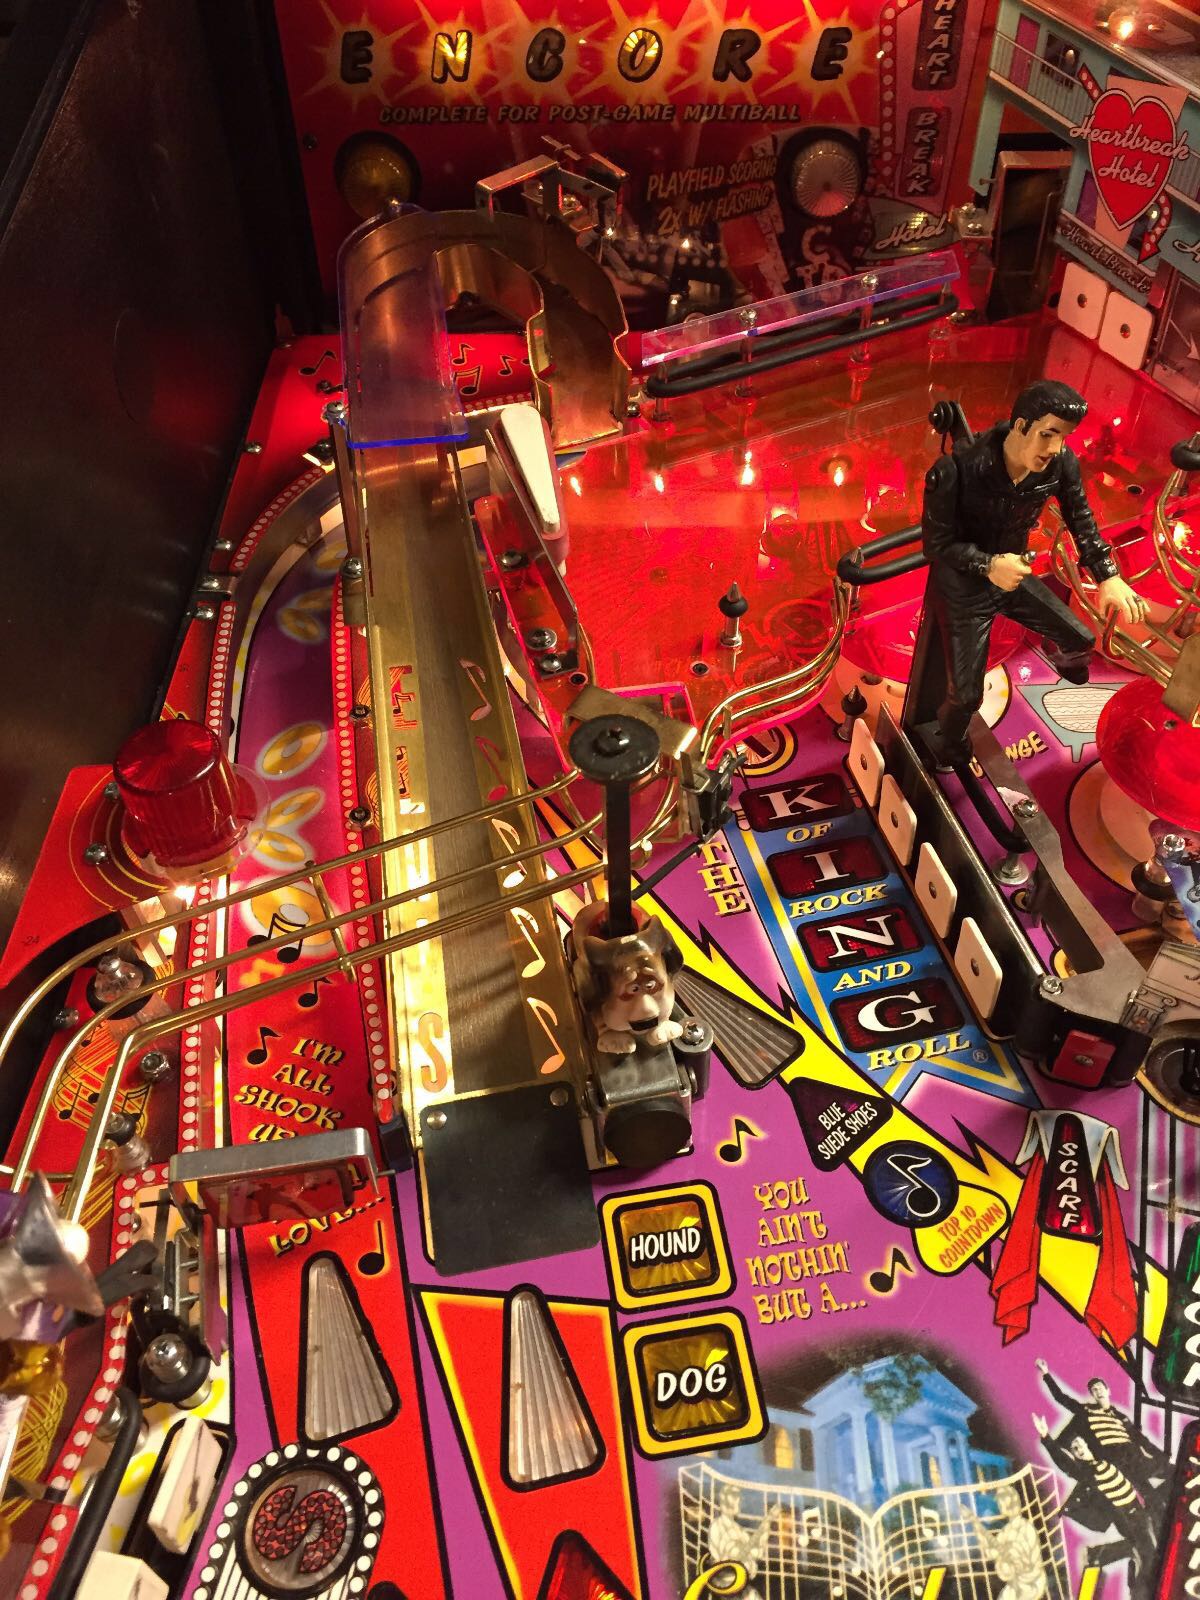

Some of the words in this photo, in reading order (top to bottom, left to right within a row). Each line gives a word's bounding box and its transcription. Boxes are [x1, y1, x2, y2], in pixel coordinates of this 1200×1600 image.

[340, 27, 853, 84] ENCORE
[379, 104, 488, 124] COMPLETE
[497, 104, 539, 122] FOR
[549, 103, 675, 122] POST-GAME
[683, 102, 801, 122] MULTIBALL
[906, 111, 939, 194] BREAK
[1069, 113, 1190, 160] Heartbreak
[647, 164, 726, 201] PLAYFIELD
[727, 156, 778, 186] SCORING
[1097, 154, 1160, 188] Hotel
[714, 186, 772, 222] FLASHING
[875, 213, 947, 250] Hotel
[786, 822, 833, 843] OF
[700, 842, 751, 917] THE
[789, 883, 890, 919] ROCK
[832, 960, 914, 993] AND
[867, 1032, 973, 1071] ROLL
[271, 1063, 335, 1096] ALL
[234, 1084, 345, 1130] SHOOK
[818, 1102, 847, 1131] BLUE
[817, 1127, 851, 1160] SUEDE
[845, 1101, 878, 1136] SHOES
[752, 1176, 811, 1212] YOU
[1056, 1142, 1083, 1228] SCARF
[757, 1211, 829, 1248] AIN'T
[937, 1219, 963, 1243] TOP
[964, 1205, 979, 1221] 10
[938, 1203, 1005, 1269] COUNTDOWN
[630, 1227, 701, 1262] HOUND
[745, 1241, 852, 1288] NOTHIN'
[752, 1287, 813, 1325] BUT
[656, 1363, 728, 1402] DOG
